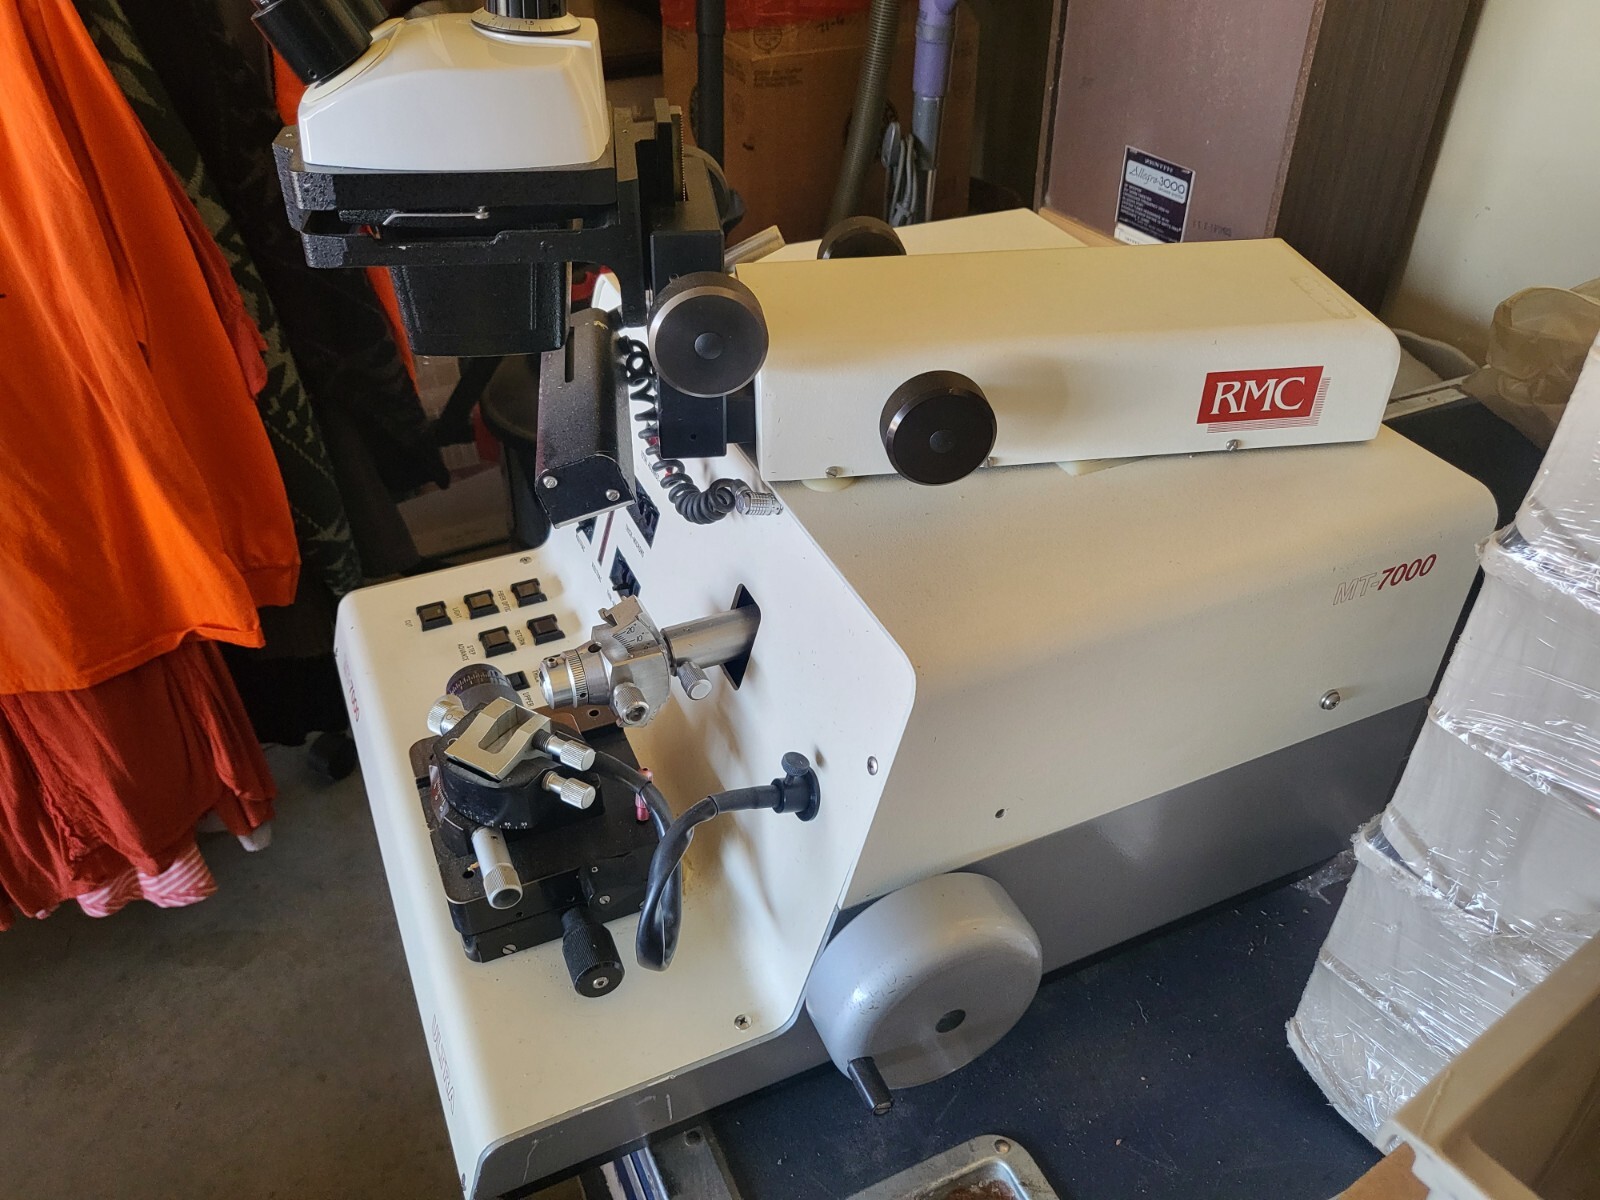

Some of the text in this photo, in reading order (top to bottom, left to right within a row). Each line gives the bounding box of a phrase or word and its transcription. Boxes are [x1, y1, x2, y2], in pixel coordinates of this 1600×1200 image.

[1158, 176, 1185, 195] 3000
[1209, 376, 1306, 415] RMC
[1332, 553, 1437, 606] MT-7000
[522, 691, 535, 707] UPPER
